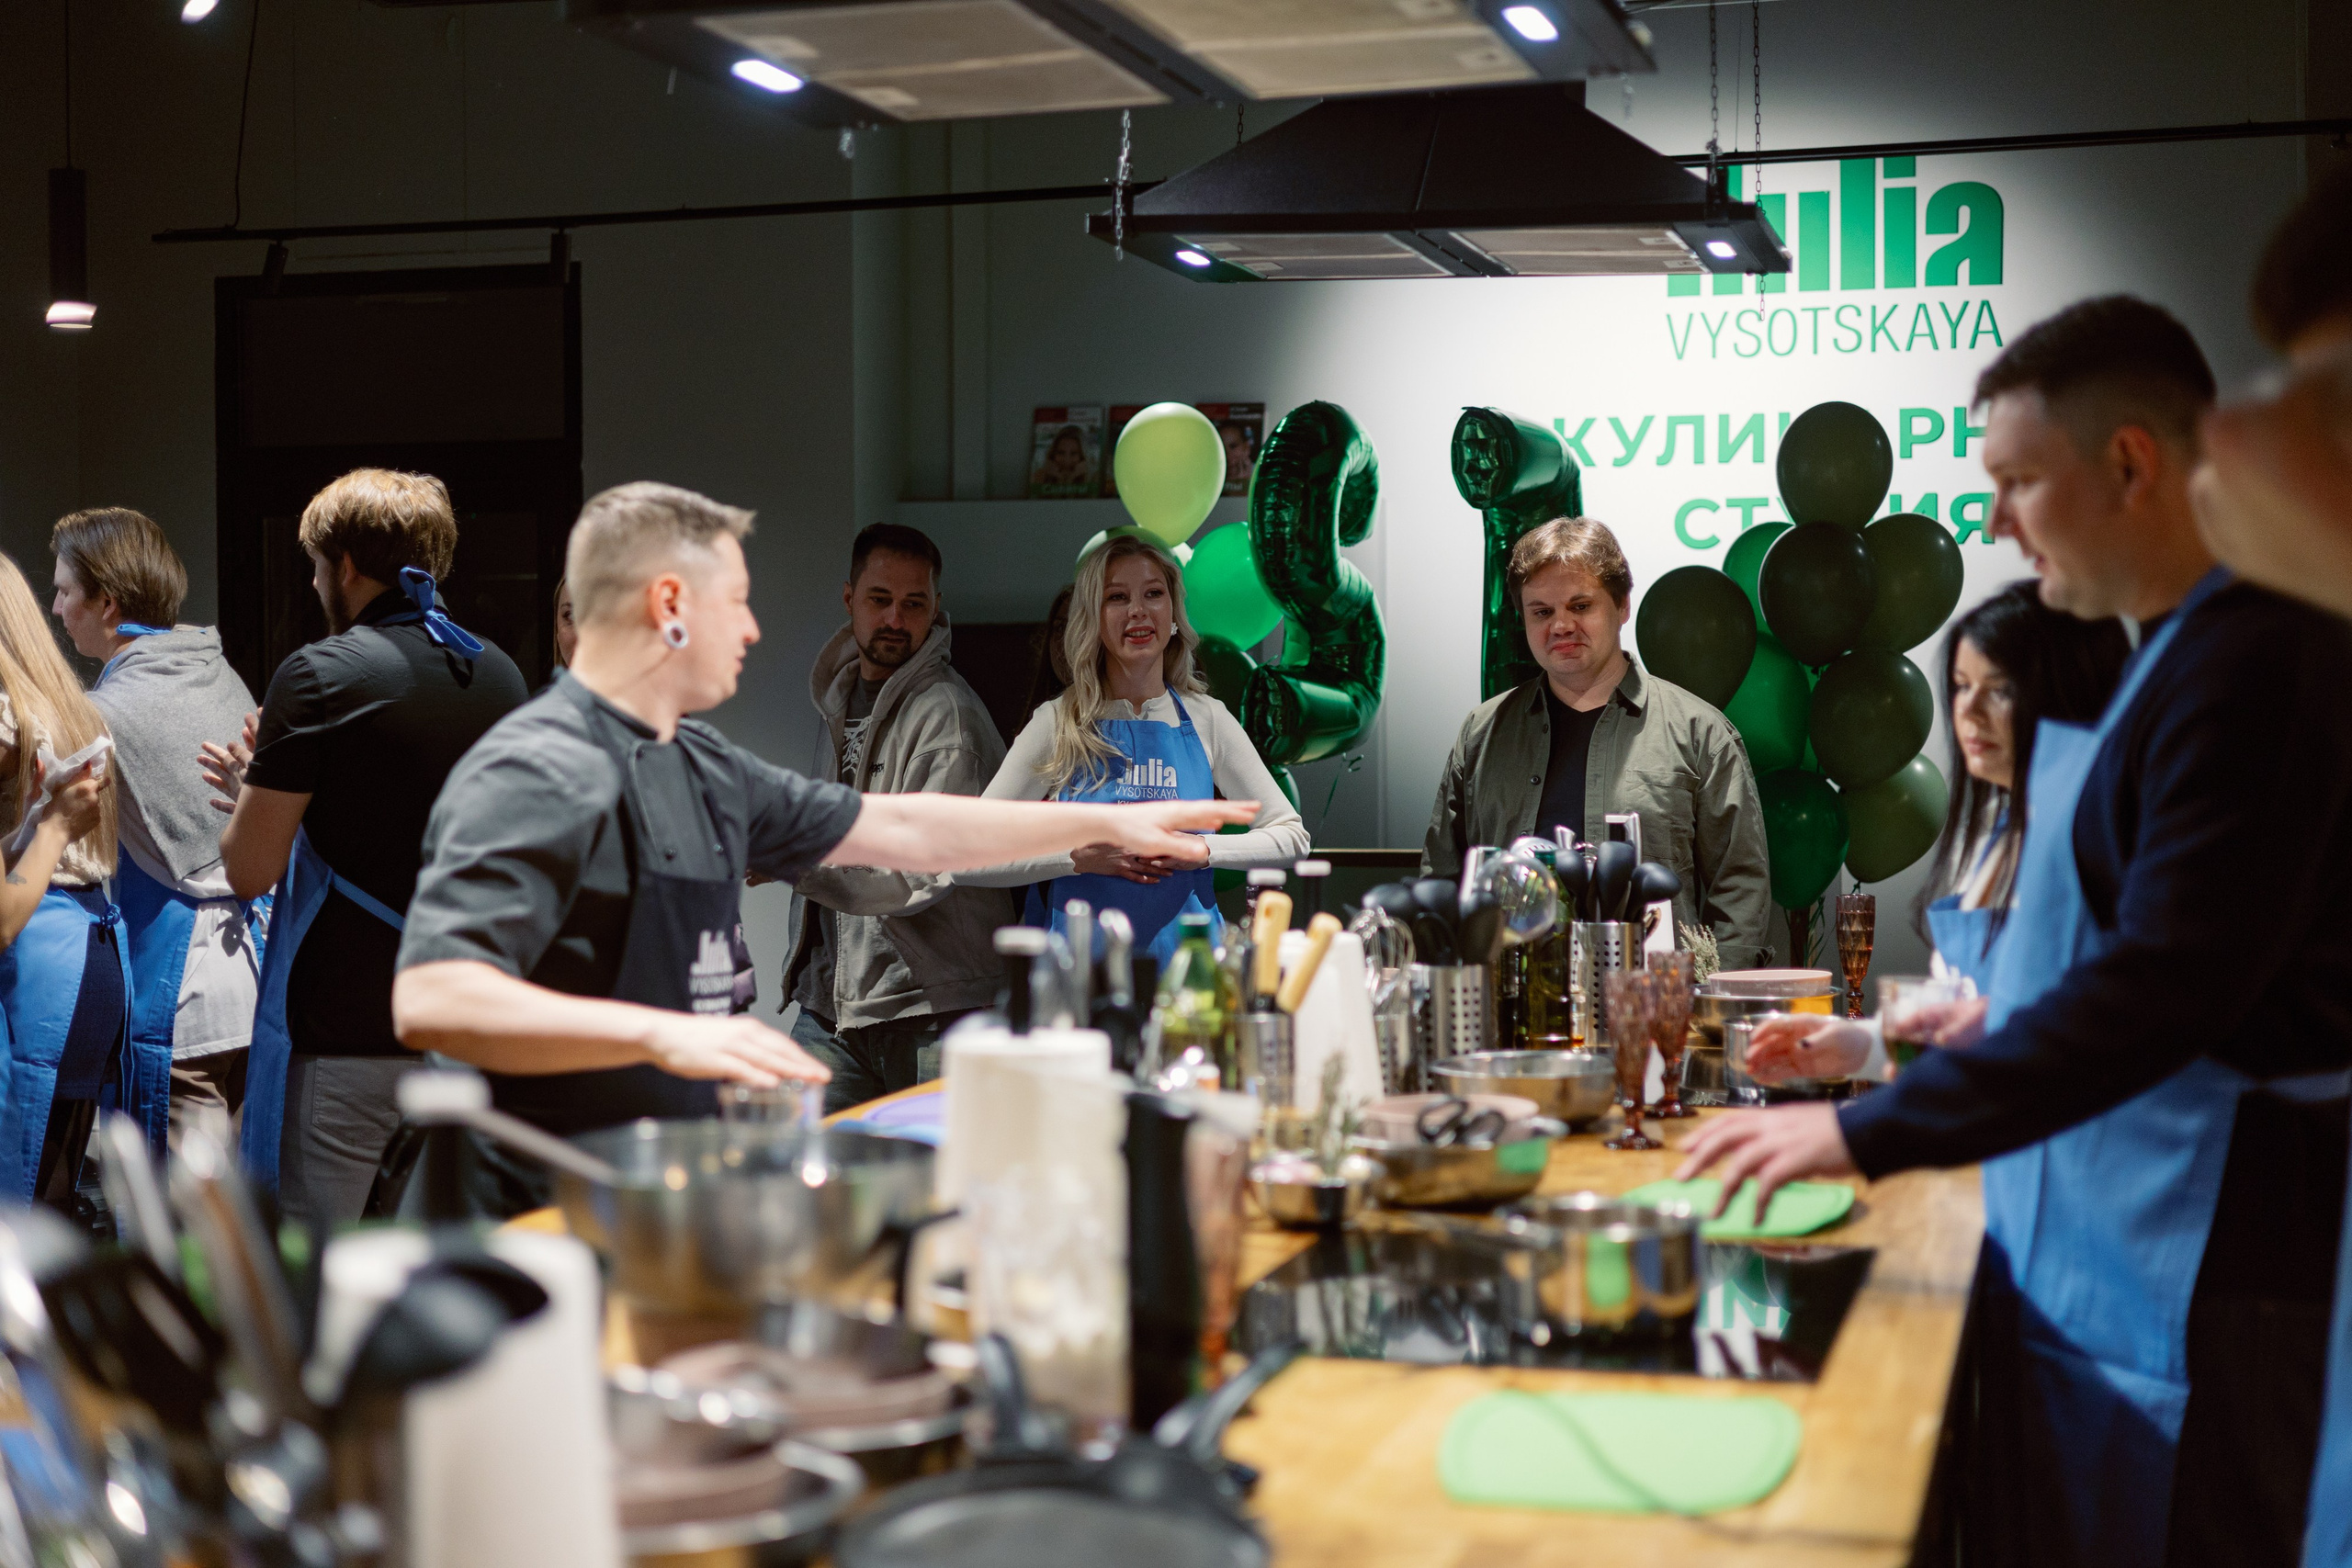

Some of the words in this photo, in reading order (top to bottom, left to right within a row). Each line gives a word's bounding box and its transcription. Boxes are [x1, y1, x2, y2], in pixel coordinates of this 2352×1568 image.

[1666, 299, 2004, 360] VYSOTSKAYA
[1554, 406, 1989, 468] КУЛИРН
[1114, 785, 1179, 800] VYSOTSKAYA
[1116, 758, 1177, 787] Julia
